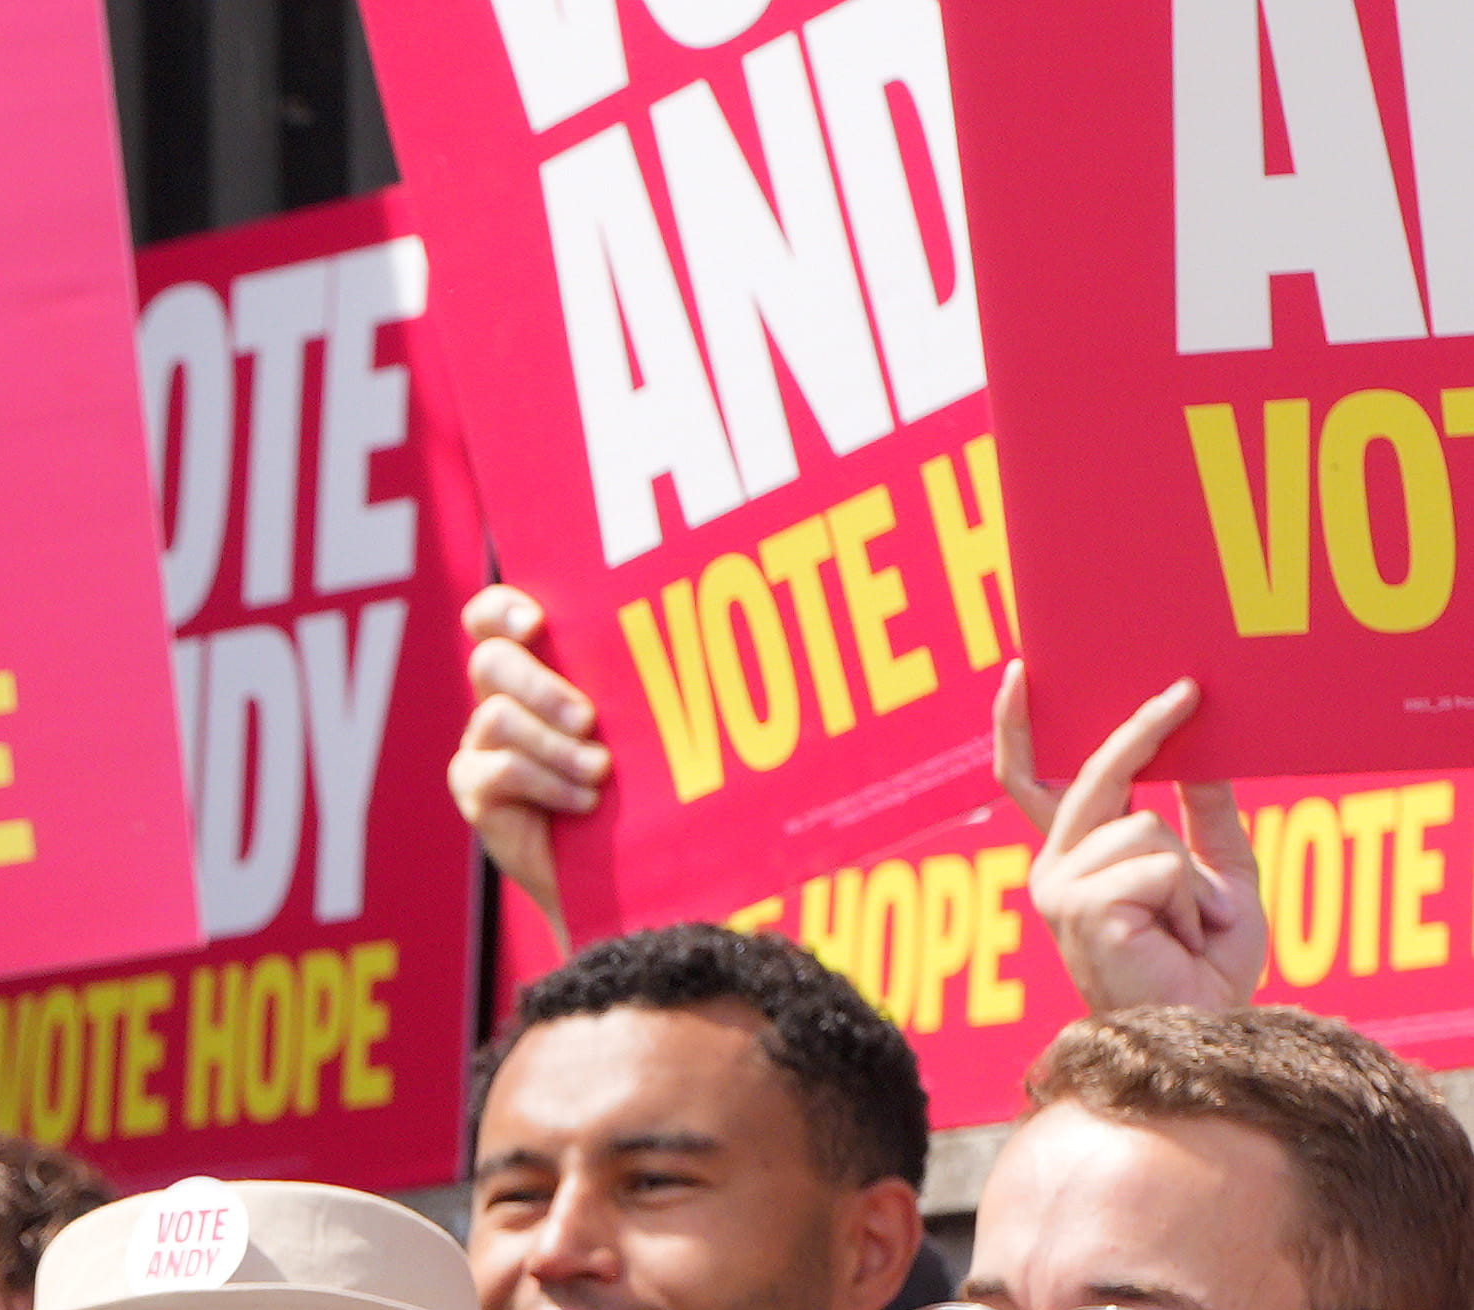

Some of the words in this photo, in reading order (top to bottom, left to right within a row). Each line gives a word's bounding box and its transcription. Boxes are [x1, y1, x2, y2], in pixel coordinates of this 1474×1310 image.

[537, 0, 988, 570] AND
[136, 235, 429, 628] OTE
[1183, 388, 1474, 638] VO
[616, 483, 938, 804] VOTE
[172, 600, 409, 940] DY
[183, 942, 400, 1134] HOPE
[798, 845, 1032, 1036] HOPE
[145, 1247, 221, 1280] ANDY
[156, 1207, 229, 1245] VOTE
